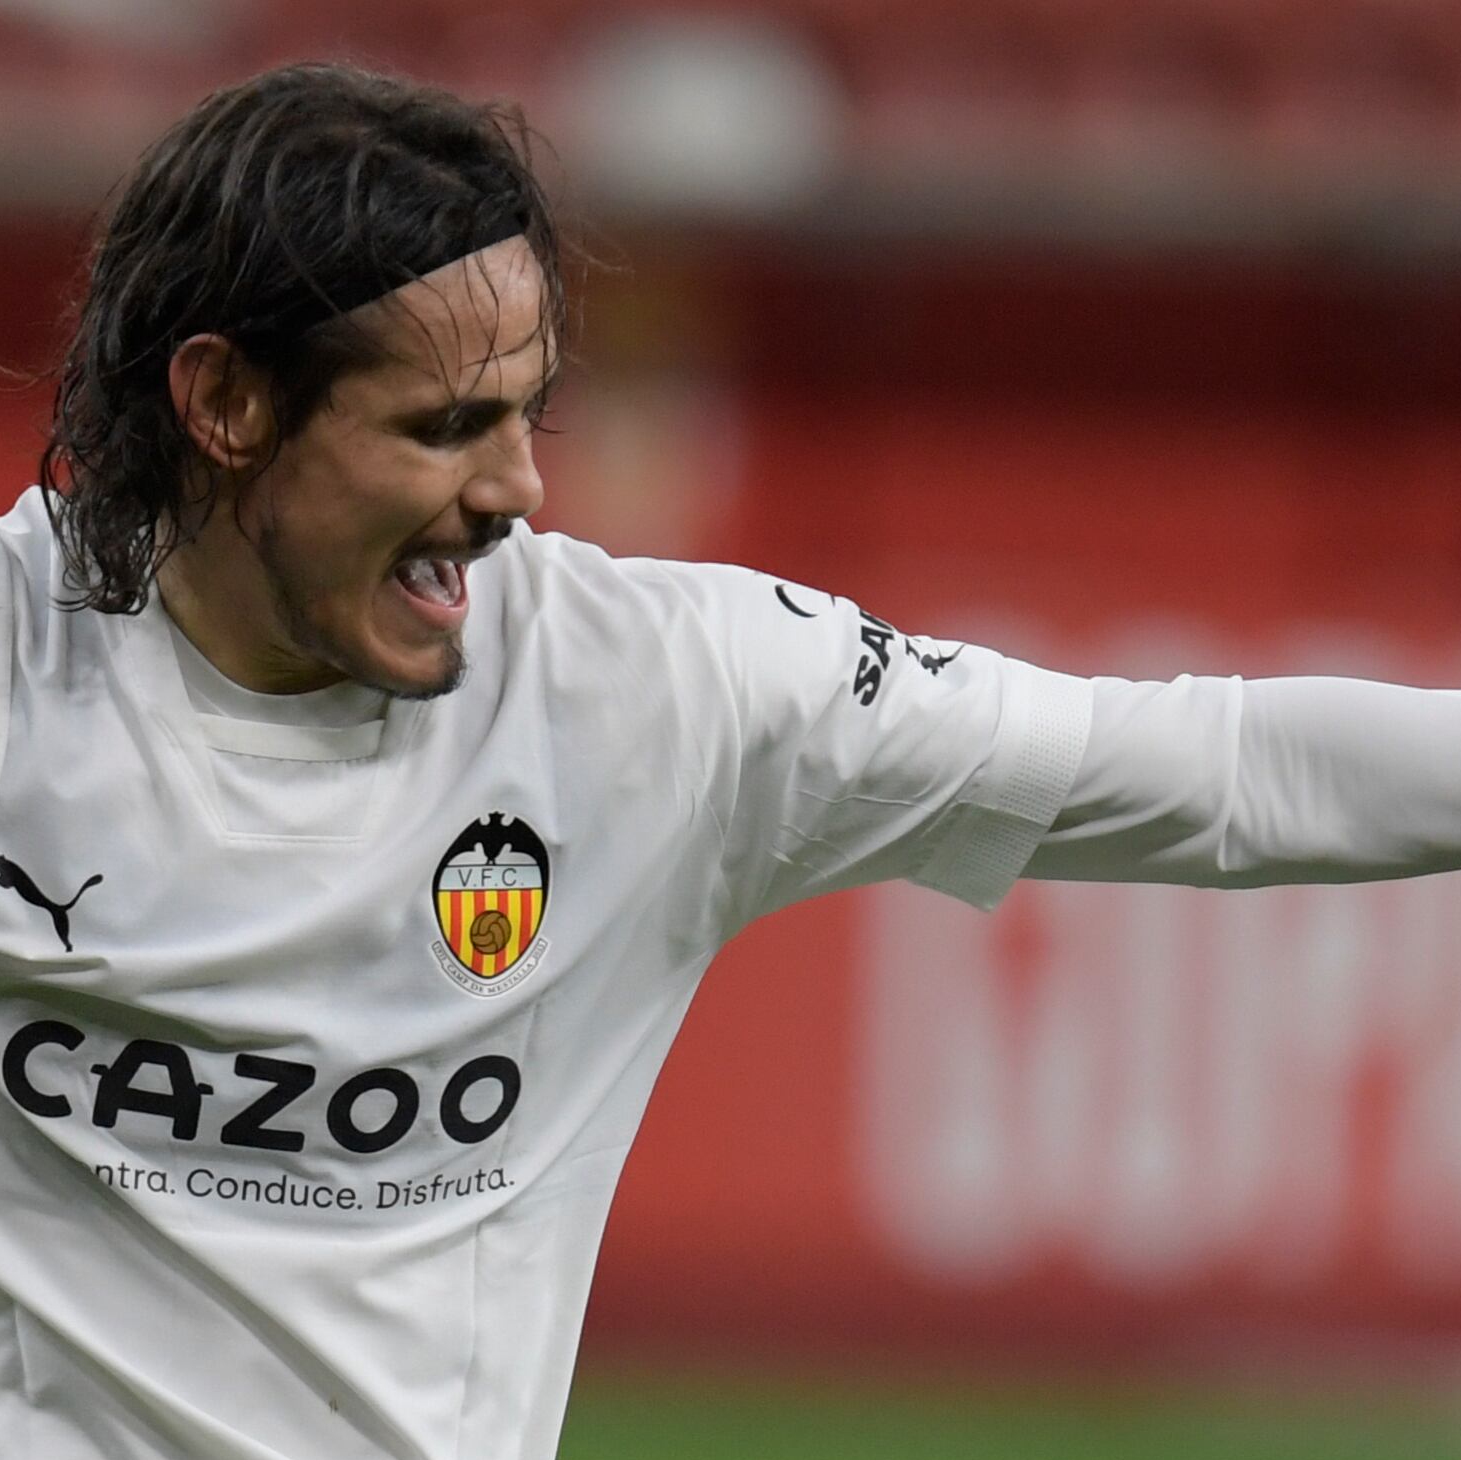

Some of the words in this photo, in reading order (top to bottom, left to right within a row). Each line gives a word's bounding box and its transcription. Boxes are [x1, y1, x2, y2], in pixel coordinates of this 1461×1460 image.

[2, 1019, 521, 1153] CAZOO
[186, 1168, 363, 1210] Conduce.
[376, 1167, 515, 1210] Disfruta.
